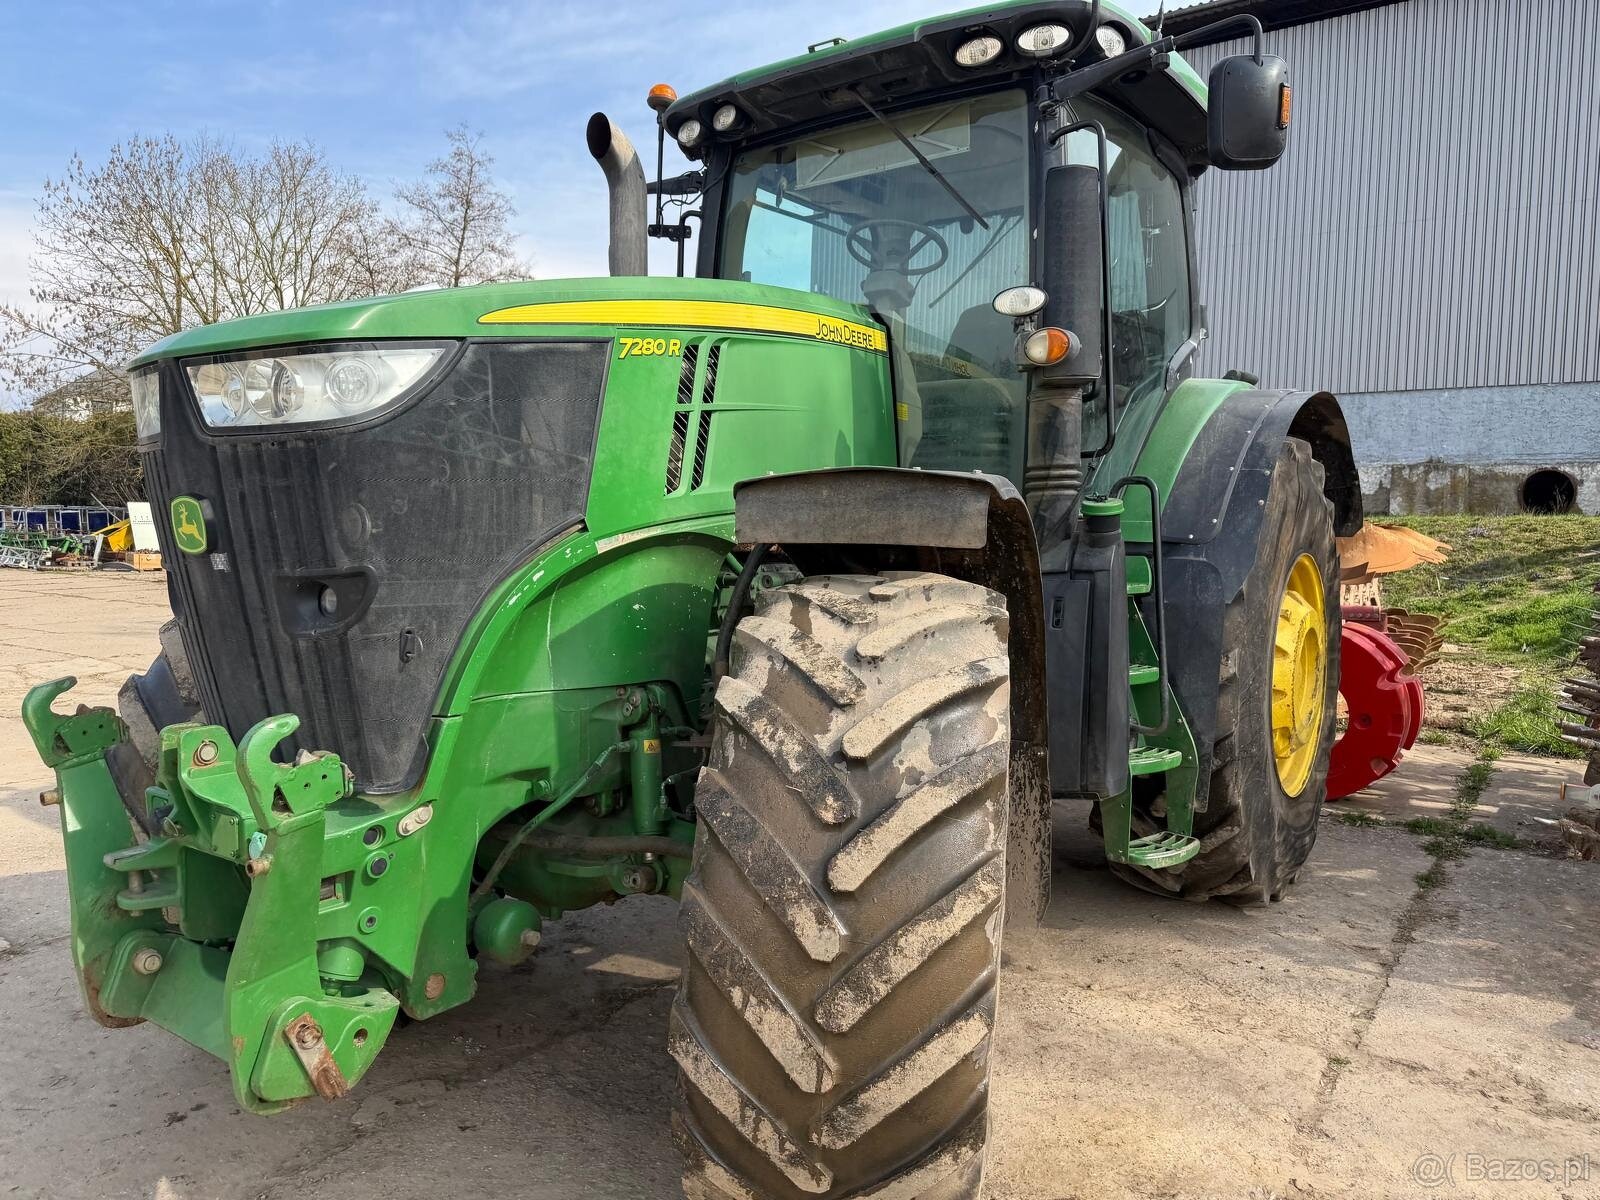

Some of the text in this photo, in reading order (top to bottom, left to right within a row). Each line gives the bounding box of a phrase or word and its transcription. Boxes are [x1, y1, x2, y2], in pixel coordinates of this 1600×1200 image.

[815, 319, 873, 347] JOHN DEERE
[618, 337, 681, 359] 7280 R
